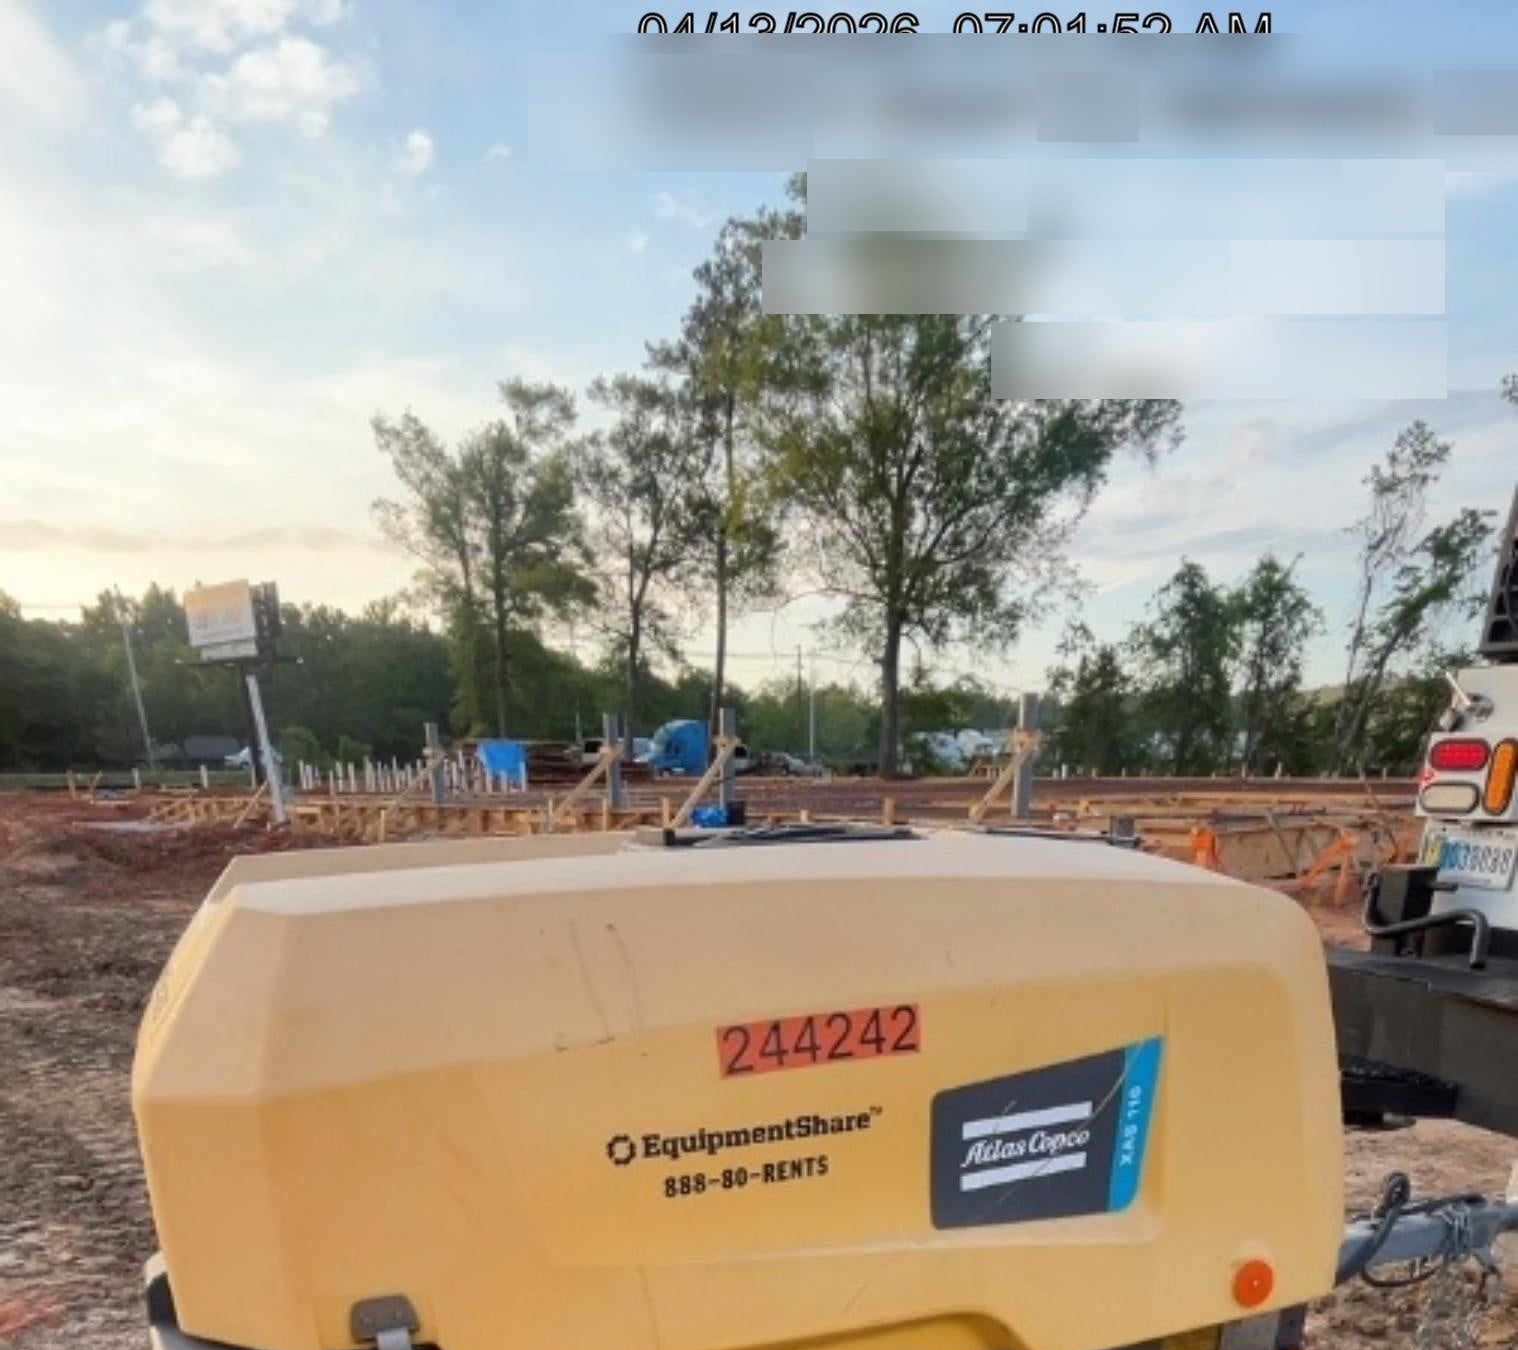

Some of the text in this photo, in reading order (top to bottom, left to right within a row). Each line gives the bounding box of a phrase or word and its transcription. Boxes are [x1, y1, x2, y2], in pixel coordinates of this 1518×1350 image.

[723, 1004, 918, 1074] 244242
[960, 1128, 1091, 1168] Atlas Copco
[664, 1154, 829, 1198] 888-80-RENTS
